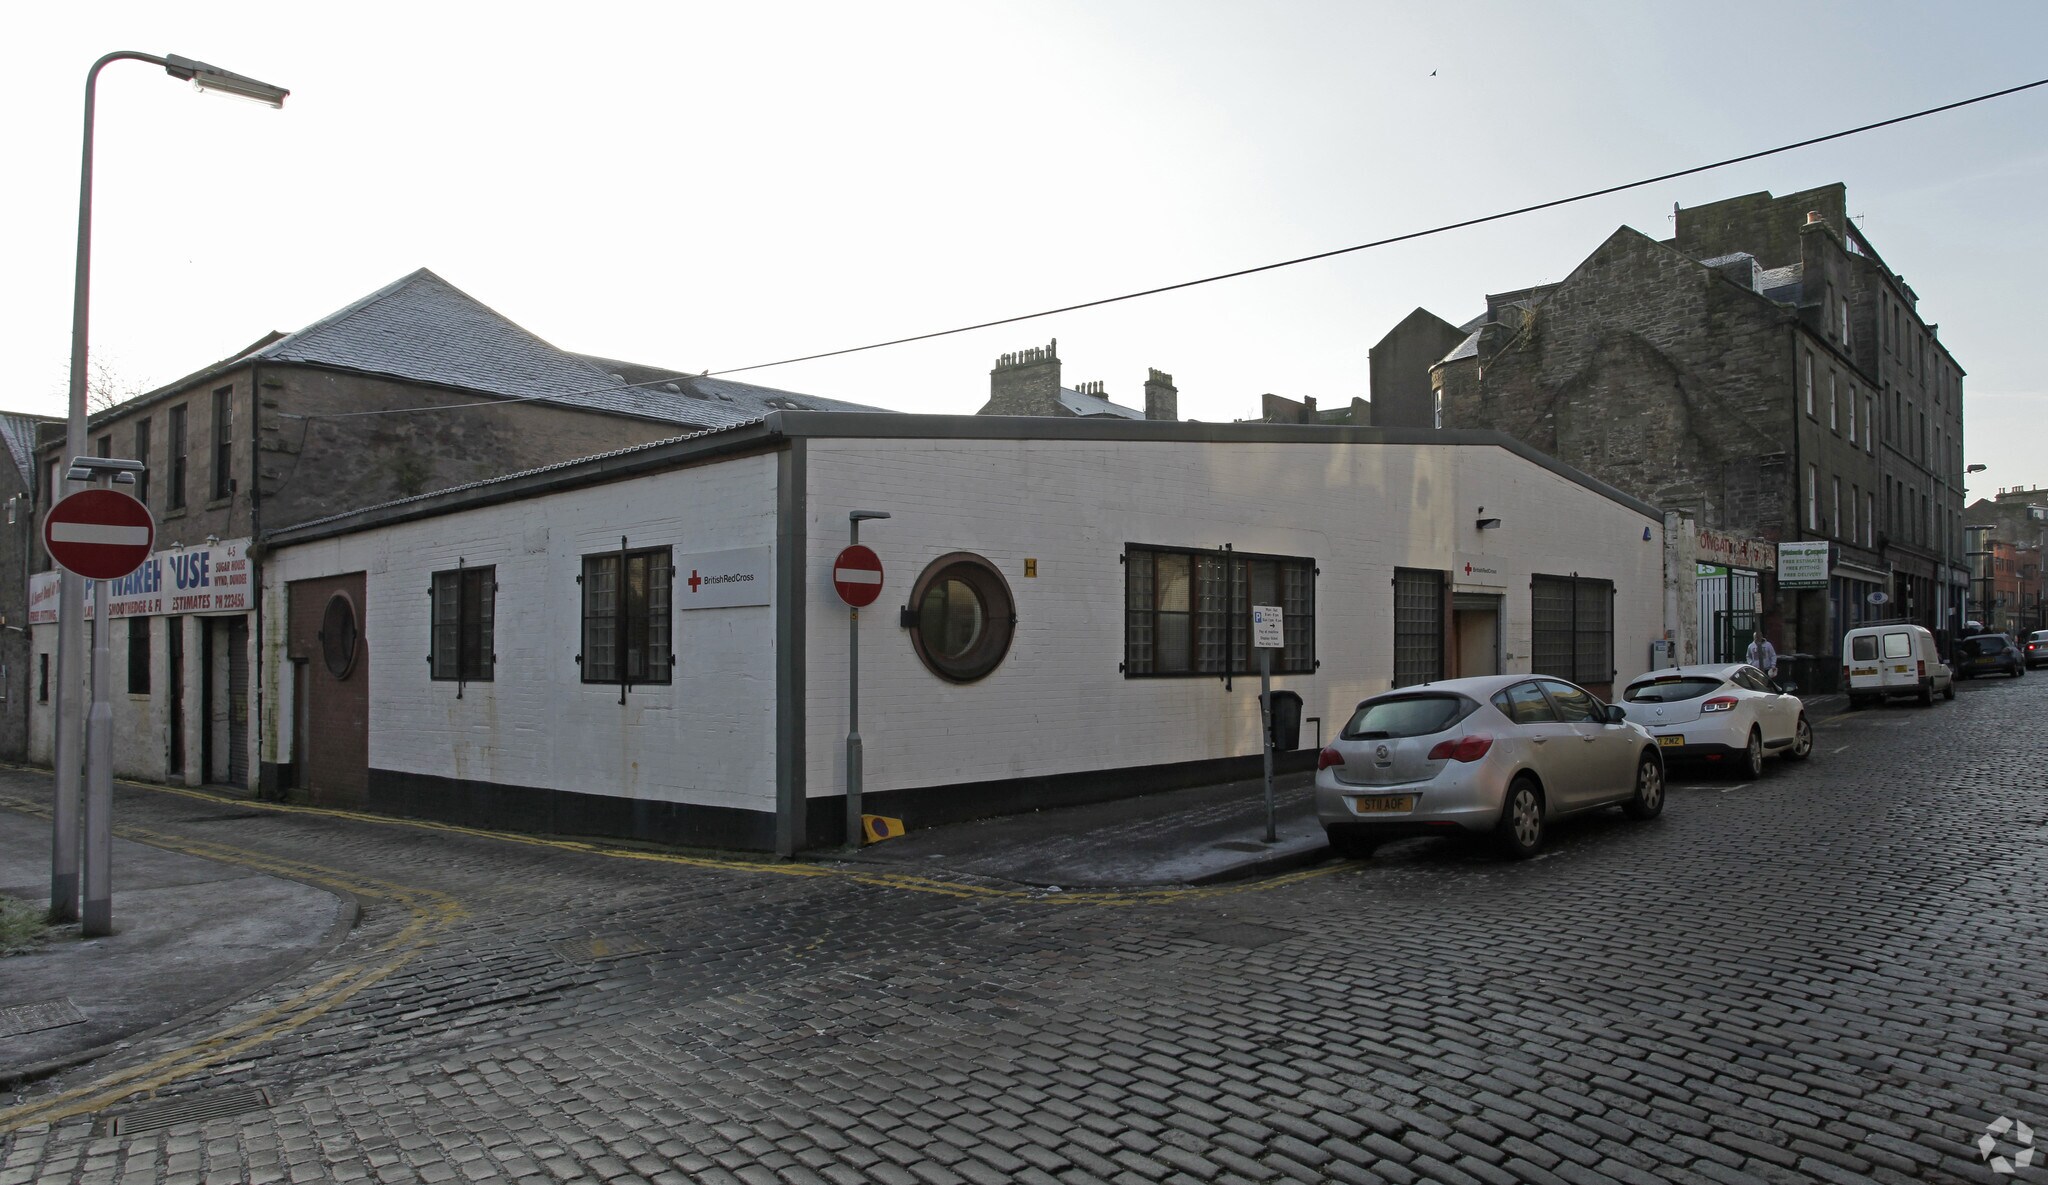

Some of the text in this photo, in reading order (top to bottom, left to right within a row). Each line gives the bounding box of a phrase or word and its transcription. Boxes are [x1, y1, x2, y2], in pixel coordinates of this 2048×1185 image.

[227, 546, 236, 558] 4-5
[215, 559, 246, 573] SUGAR HOUSE
[214, 573, 248, 588] WYND, DUNDEE
[108, 601, 147, 616] SMOOTHEDGE
[148, 600, 153, 612] &
[215, 595, 223, 609] PH
[1664, 737, 1680, 745] ZMZ
[1364, 798, 1404, 810] ST11 AOF
